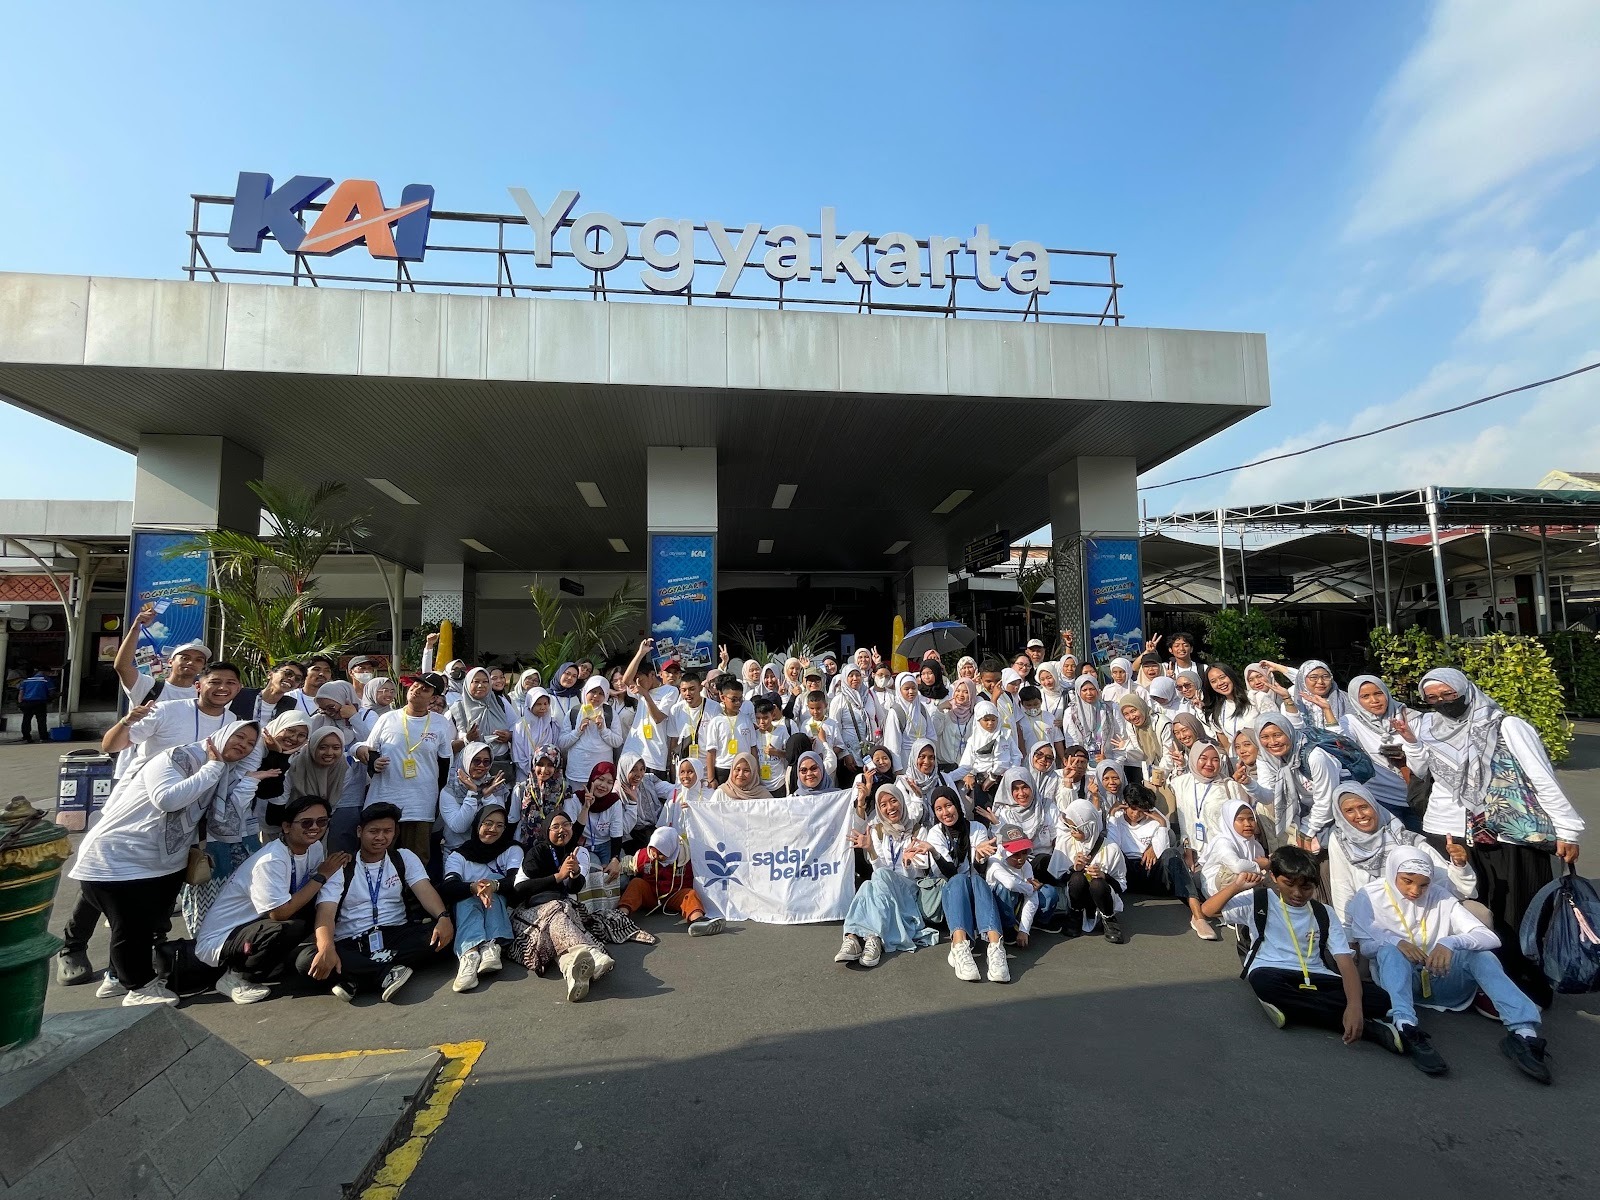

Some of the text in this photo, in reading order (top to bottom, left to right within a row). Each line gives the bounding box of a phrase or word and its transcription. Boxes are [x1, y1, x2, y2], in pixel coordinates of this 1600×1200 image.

[228, 171, 1051, 296] KAI Yogyakarta
[690, 550, 706, 558] KAI
[658, 581, 707, 596] YOGYAKARTA
[752, 846, 810, 867] sadar
[770, 858, 841, 881] belajar
